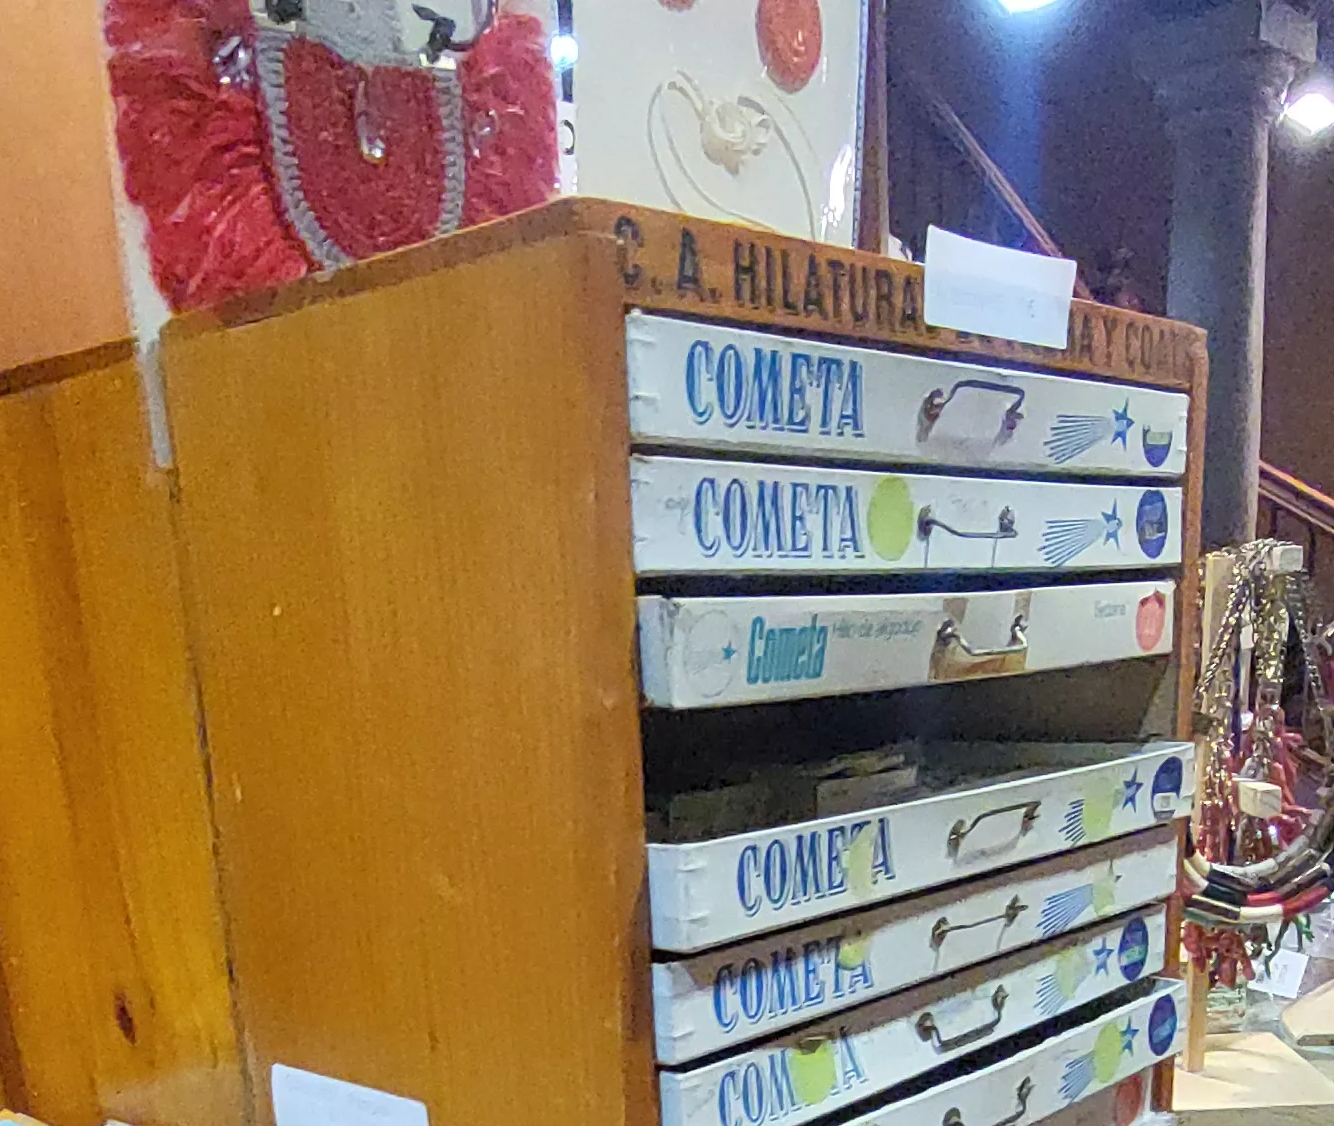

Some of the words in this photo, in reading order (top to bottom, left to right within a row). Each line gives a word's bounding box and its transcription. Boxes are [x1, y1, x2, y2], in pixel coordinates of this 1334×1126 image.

[733, 238, 941, 341] HILATURA
[685, 339, 866, 438] COMETA
[693, 477, 867, 559] COMETA
[746, 613, 829, 685] Cometa
